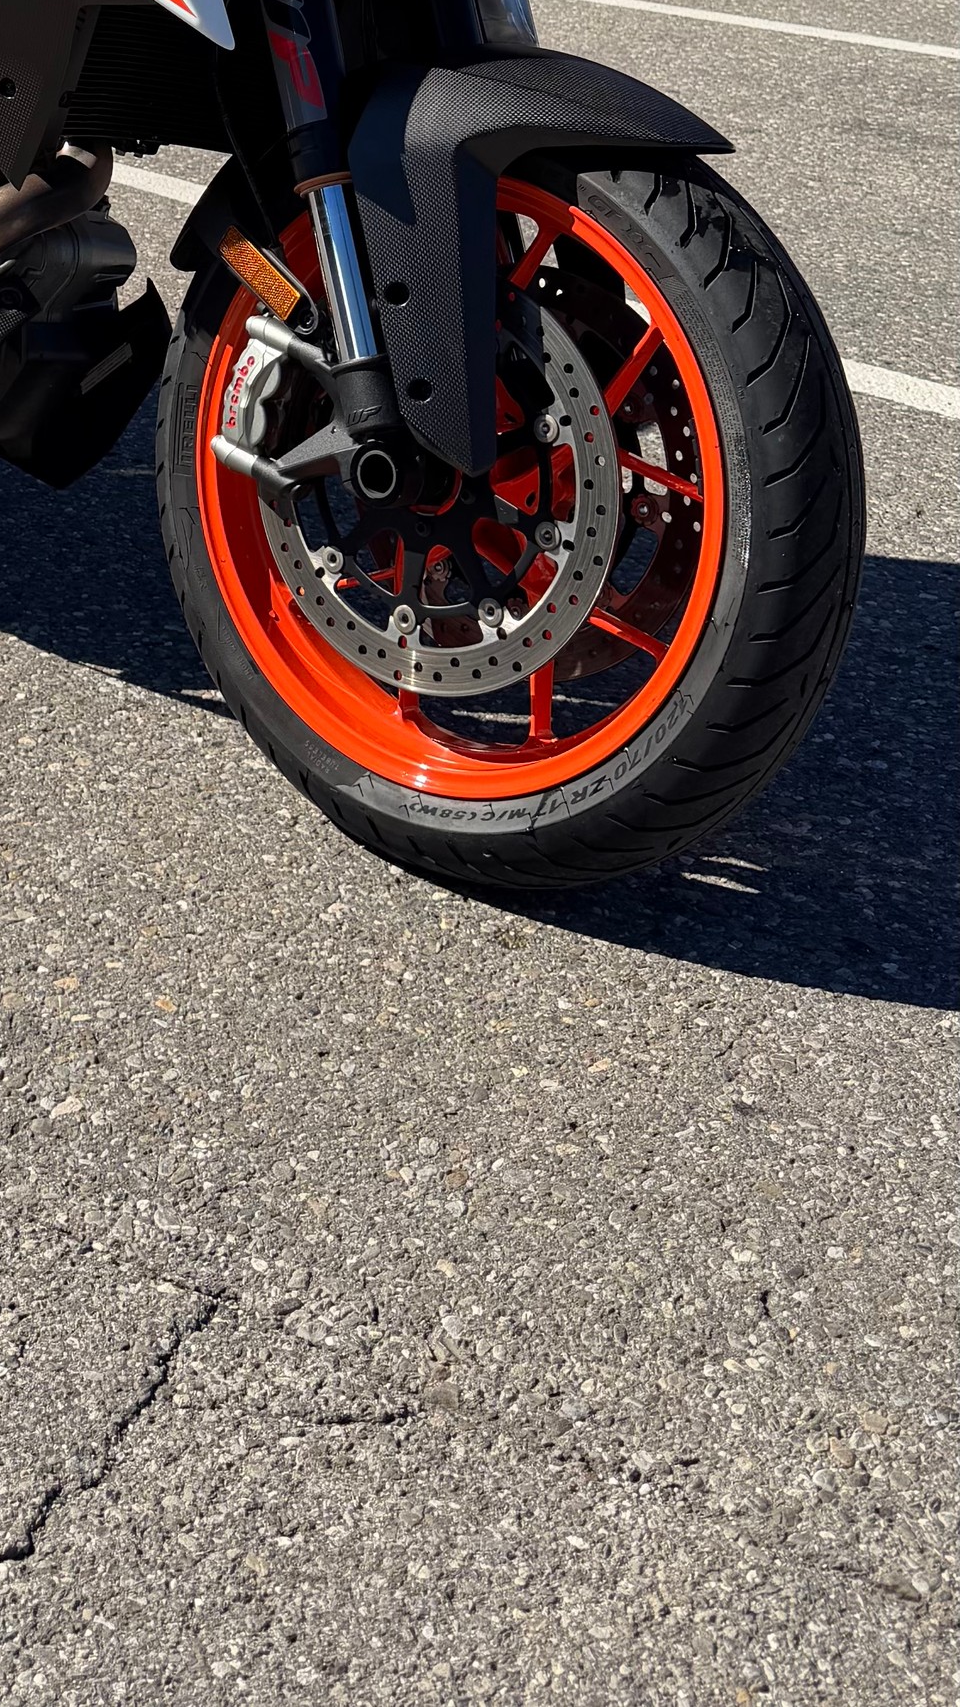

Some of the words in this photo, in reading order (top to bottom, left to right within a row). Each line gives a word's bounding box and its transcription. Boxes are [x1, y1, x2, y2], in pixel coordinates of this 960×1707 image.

[225, 355, 255, 429] brembo
[613, 699, 688, 782] 120/70
[570, 775, 607, 806] ZR
